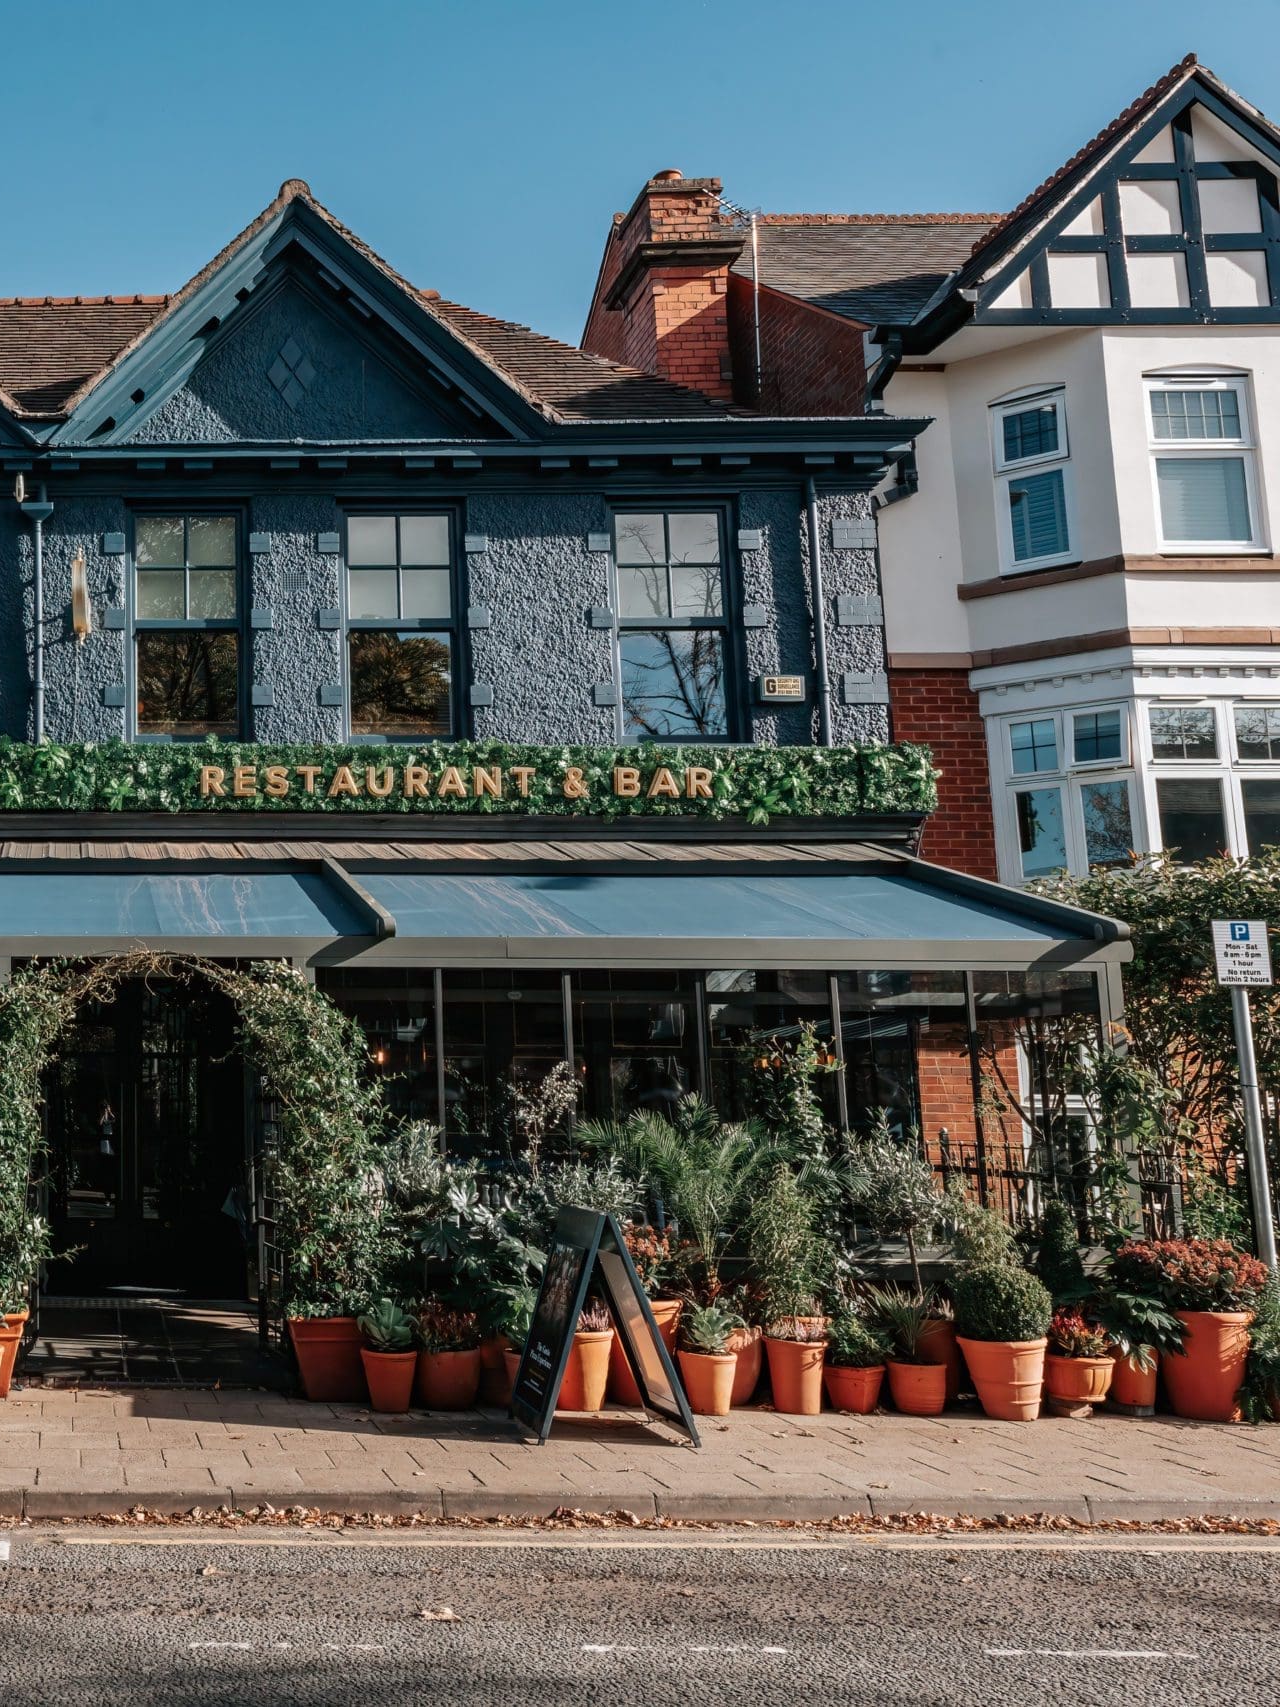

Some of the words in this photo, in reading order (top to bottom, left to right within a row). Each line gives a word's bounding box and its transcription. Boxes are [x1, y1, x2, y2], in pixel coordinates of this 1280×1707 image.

[200, 765, 536, 798] RESTAURANT
[563, 766, 590, 798] &
[613, 767, 714, 798] BAR
[1234, 924, 1246, 939] P
